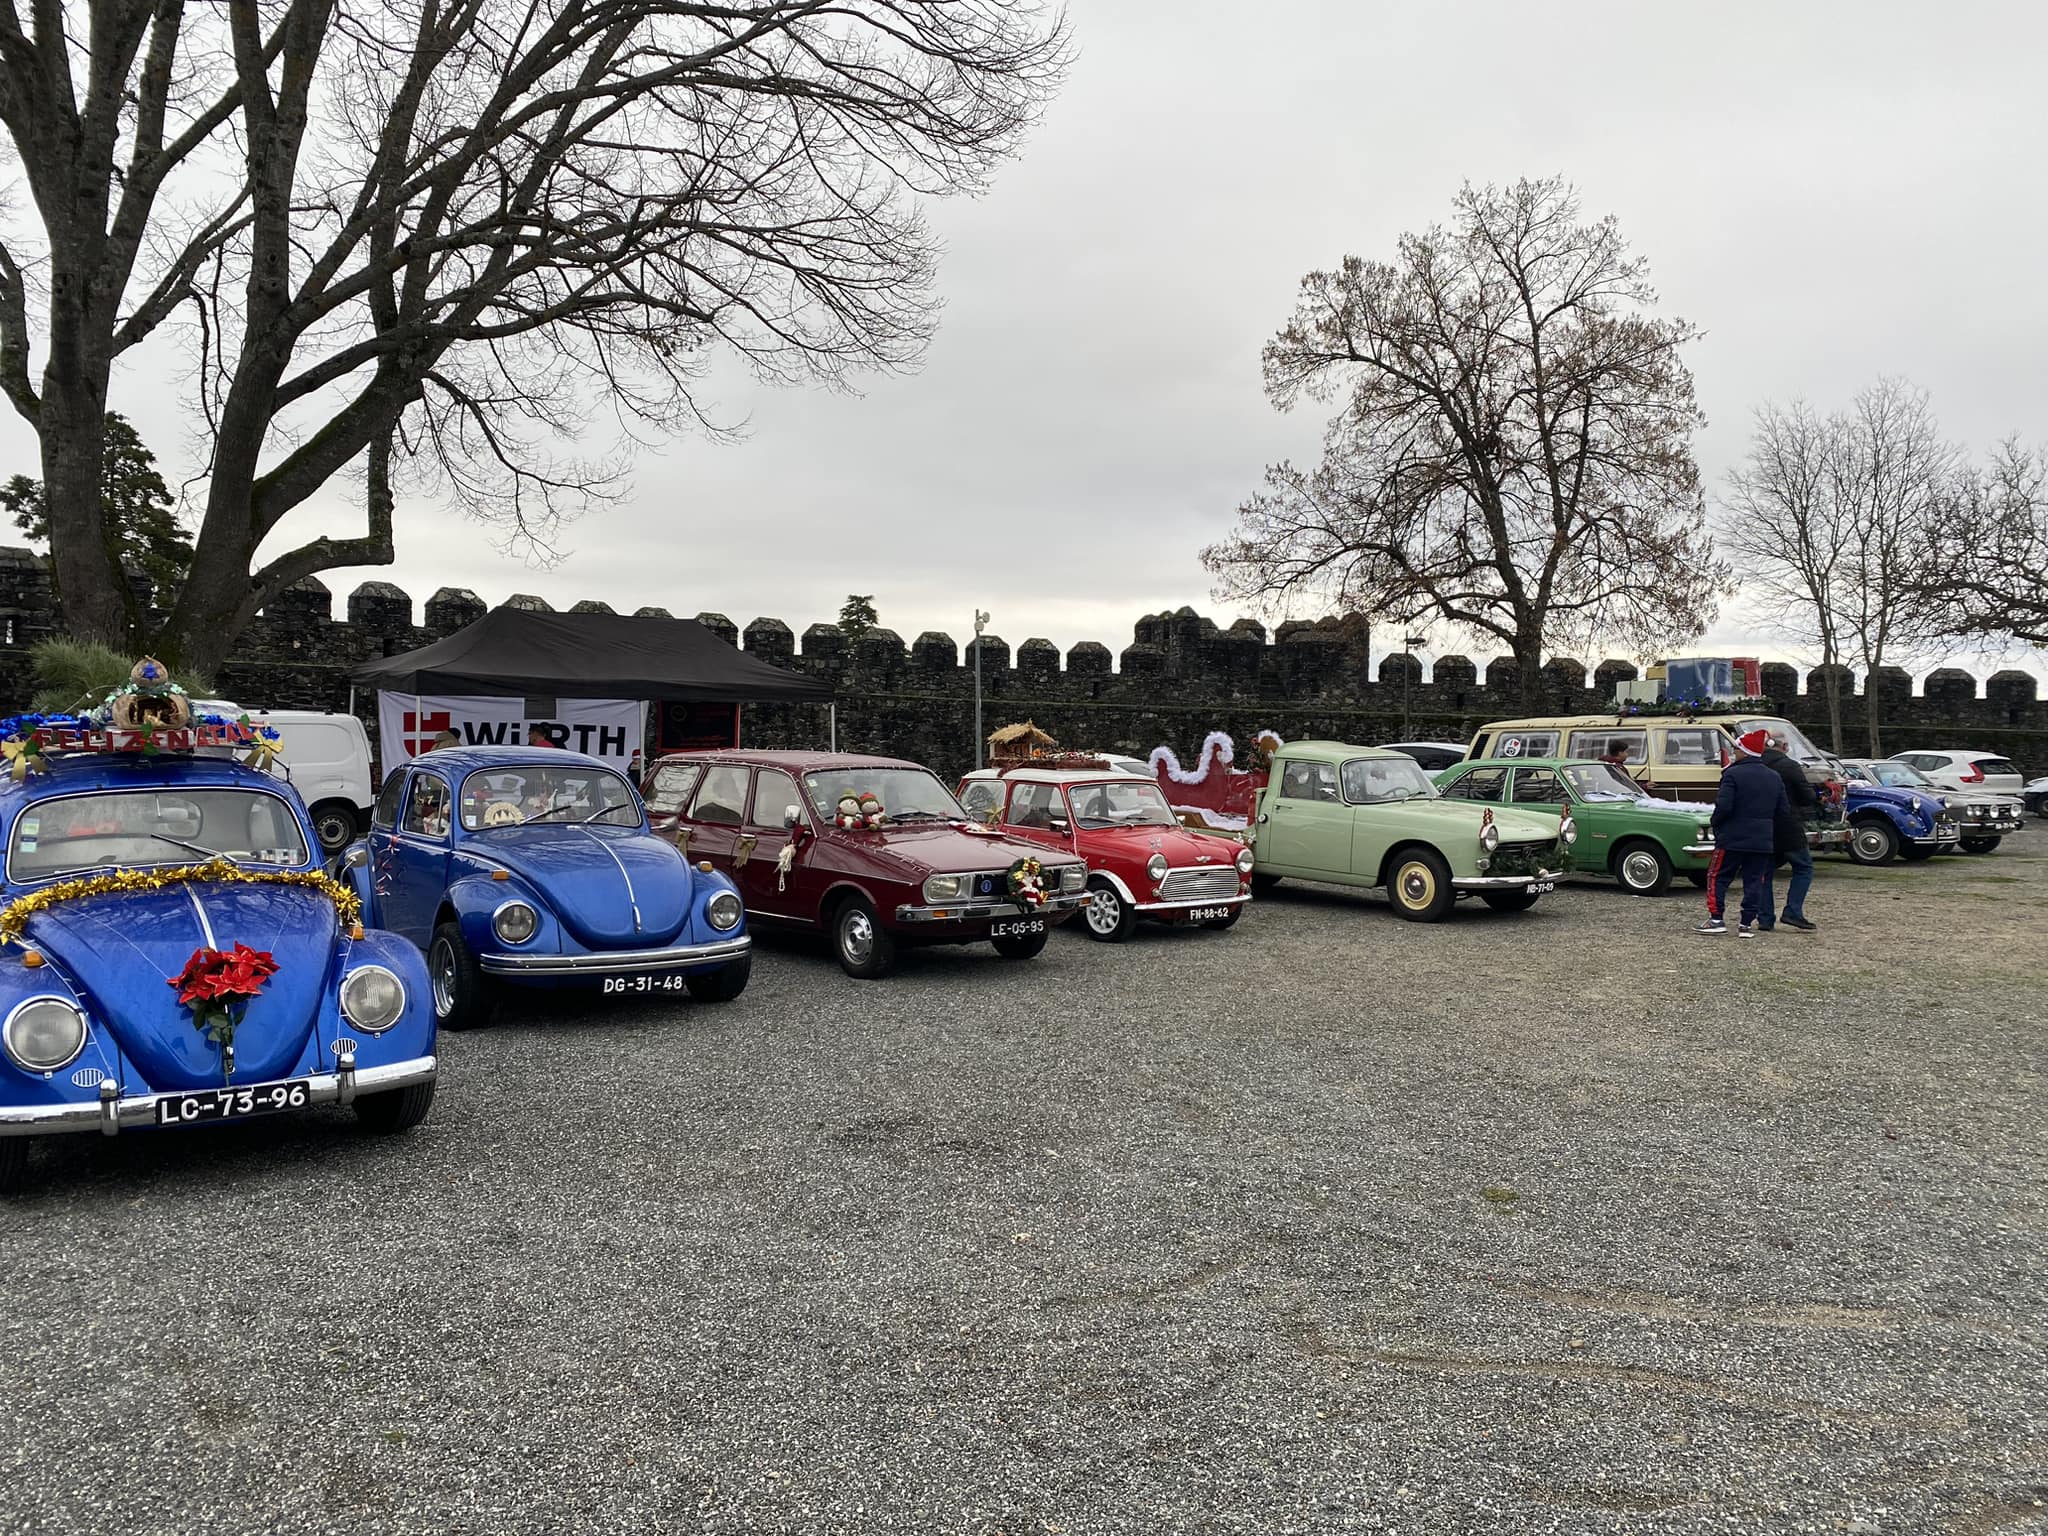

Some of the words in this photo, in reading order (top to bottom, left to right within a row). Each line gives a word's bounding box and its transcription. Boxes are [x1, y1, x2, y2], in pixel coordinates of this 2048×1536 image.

[34, 727, 146, 752] FELIZ
[166, 720, 255, 749] NATAL
[991, 920, 1045, 936] LE-05-95
[603, 975, 683, 994] DG-31-48
[160, 1085, 306, 1124] LC-73-96
